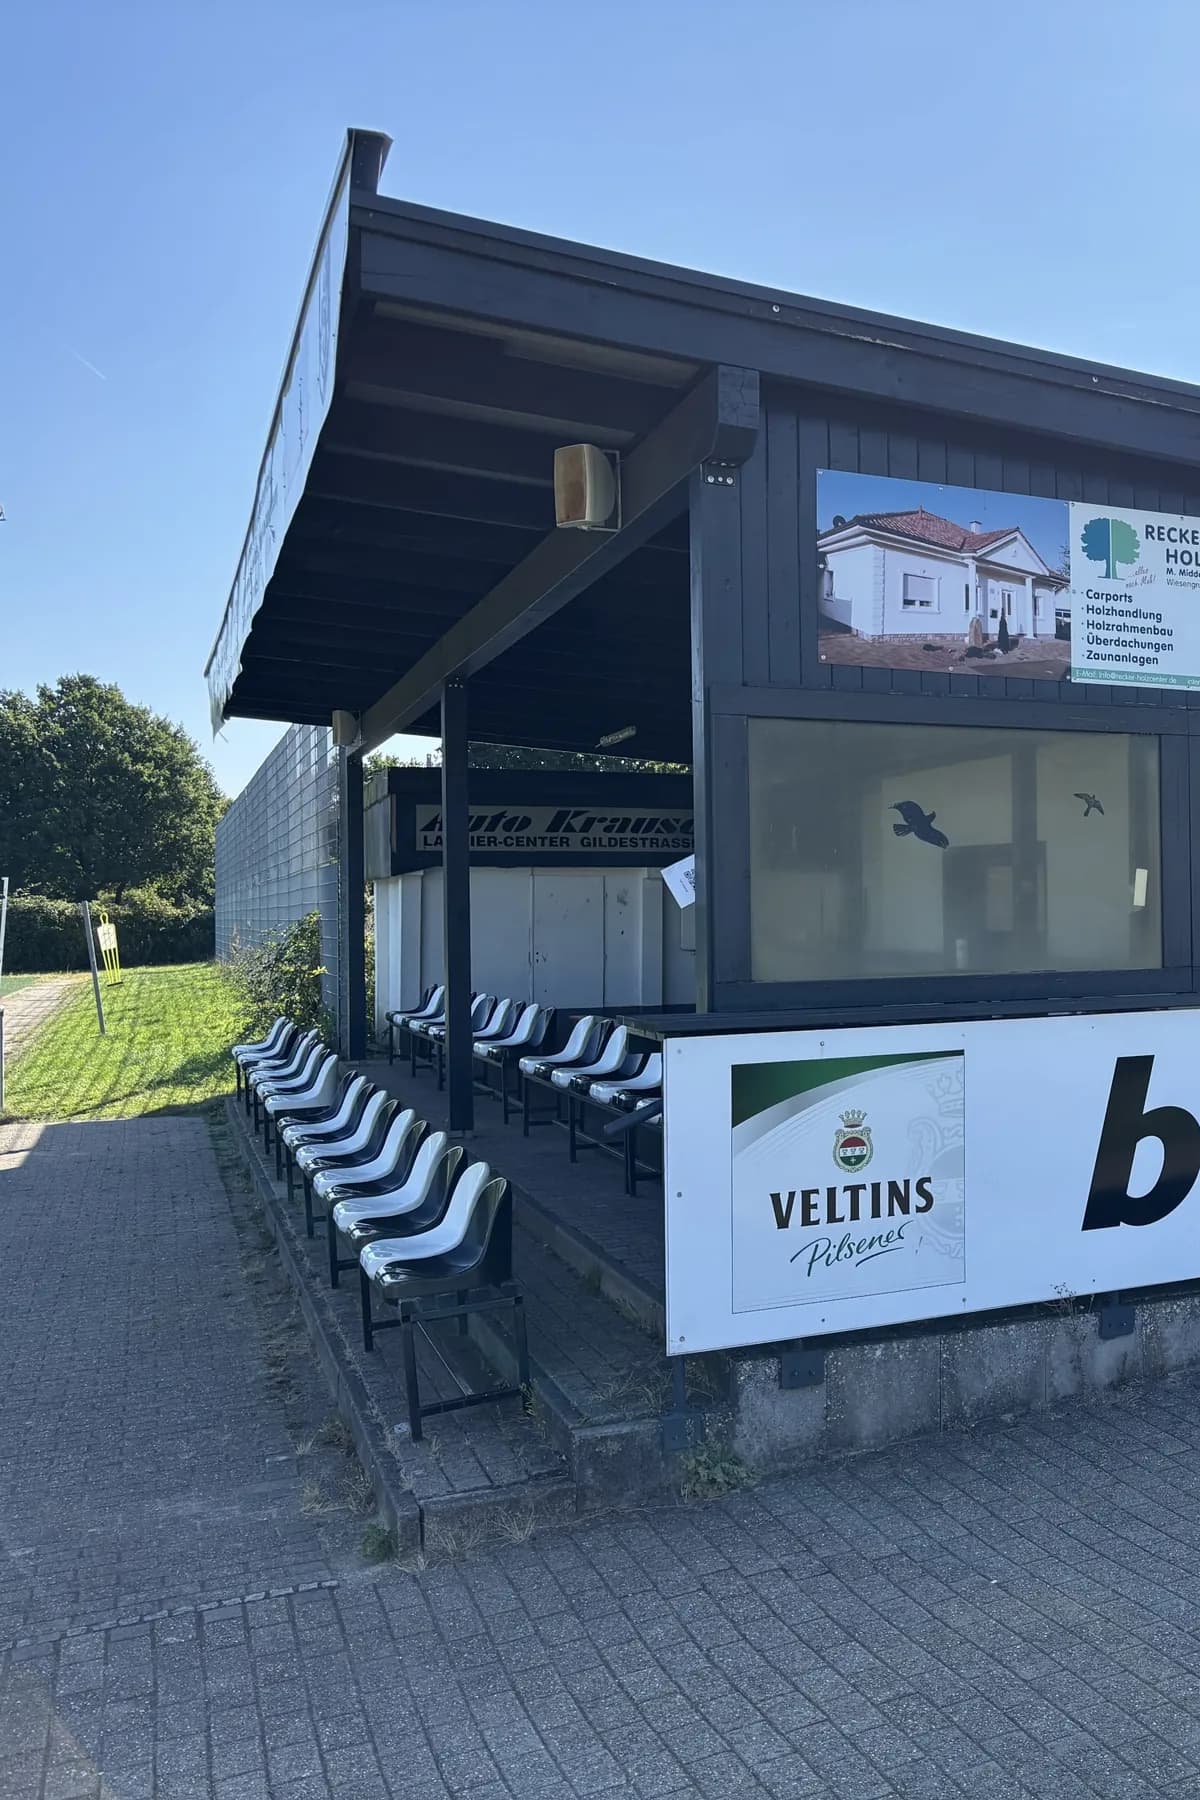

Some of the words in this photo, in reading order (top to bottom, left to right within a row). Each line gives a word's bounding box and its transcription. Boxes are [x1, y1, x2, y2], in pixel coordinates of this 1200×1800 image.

[1166, 567, 1176, 576] M.
[1086, 589, 1133, 603] Carports
[1086, 604, 1162, 623] Holzhandlung
[1086, 619, 1173, 636] Holzrahmenbau
[1086, 632, 1174, 653] Überdachungen
[1086, 649, 1159, 666] Zaunanlagen
[423, 835, 570, 848] LAIER-CENTER
[769, 1176, 935, 1229] VELTINS
[790, 1220, 914, 1277] Pilsener
